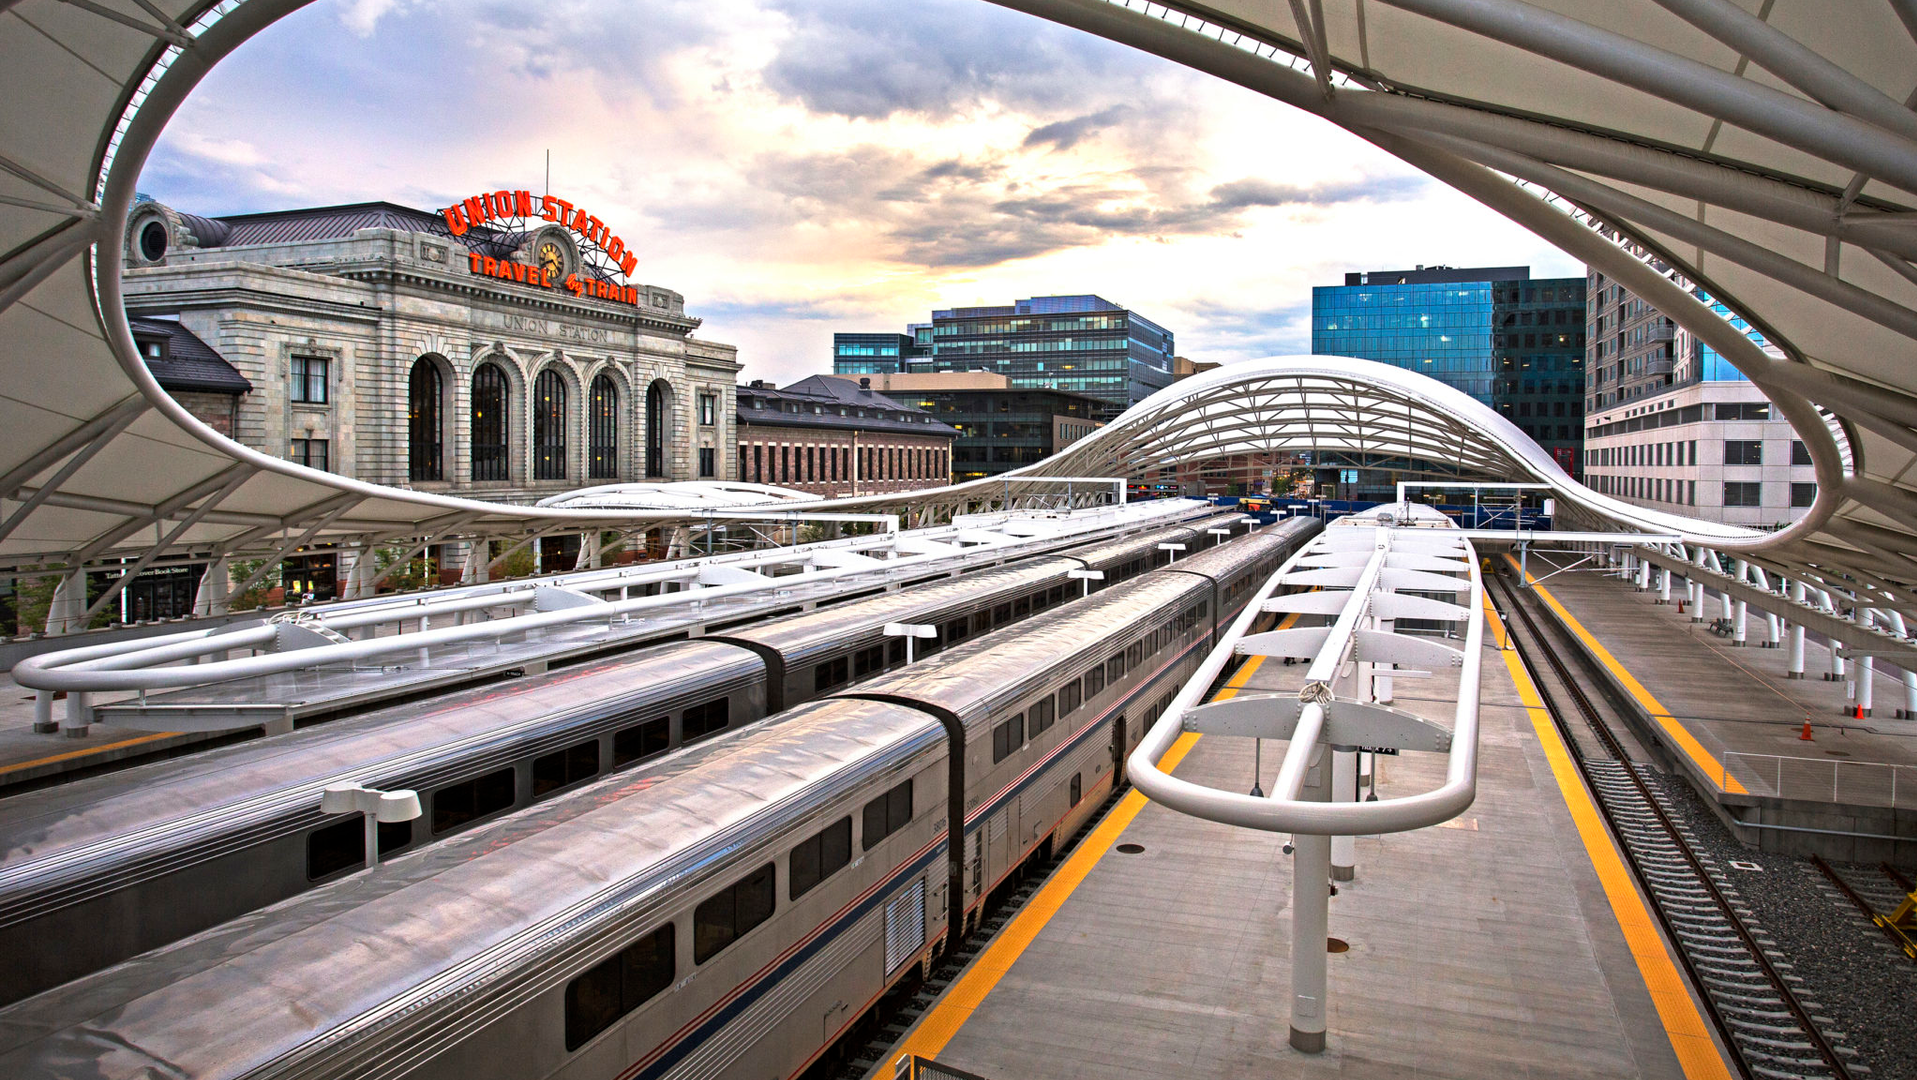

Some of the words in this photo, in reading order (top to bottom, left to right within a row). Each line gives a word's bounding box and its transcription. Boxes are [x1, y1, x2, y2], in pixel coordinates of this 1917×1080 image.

[443, 190, 532, 236] UNION
[542, 195, 638, 277] STATION
[469, 252, 552, 287] TRAVEL
[565, 273, 584, 298] by
[585, 278, 637, 305] TRAIN
[503, 315, 548, 334] UNION
[559, 324, 608, 343] STATION
